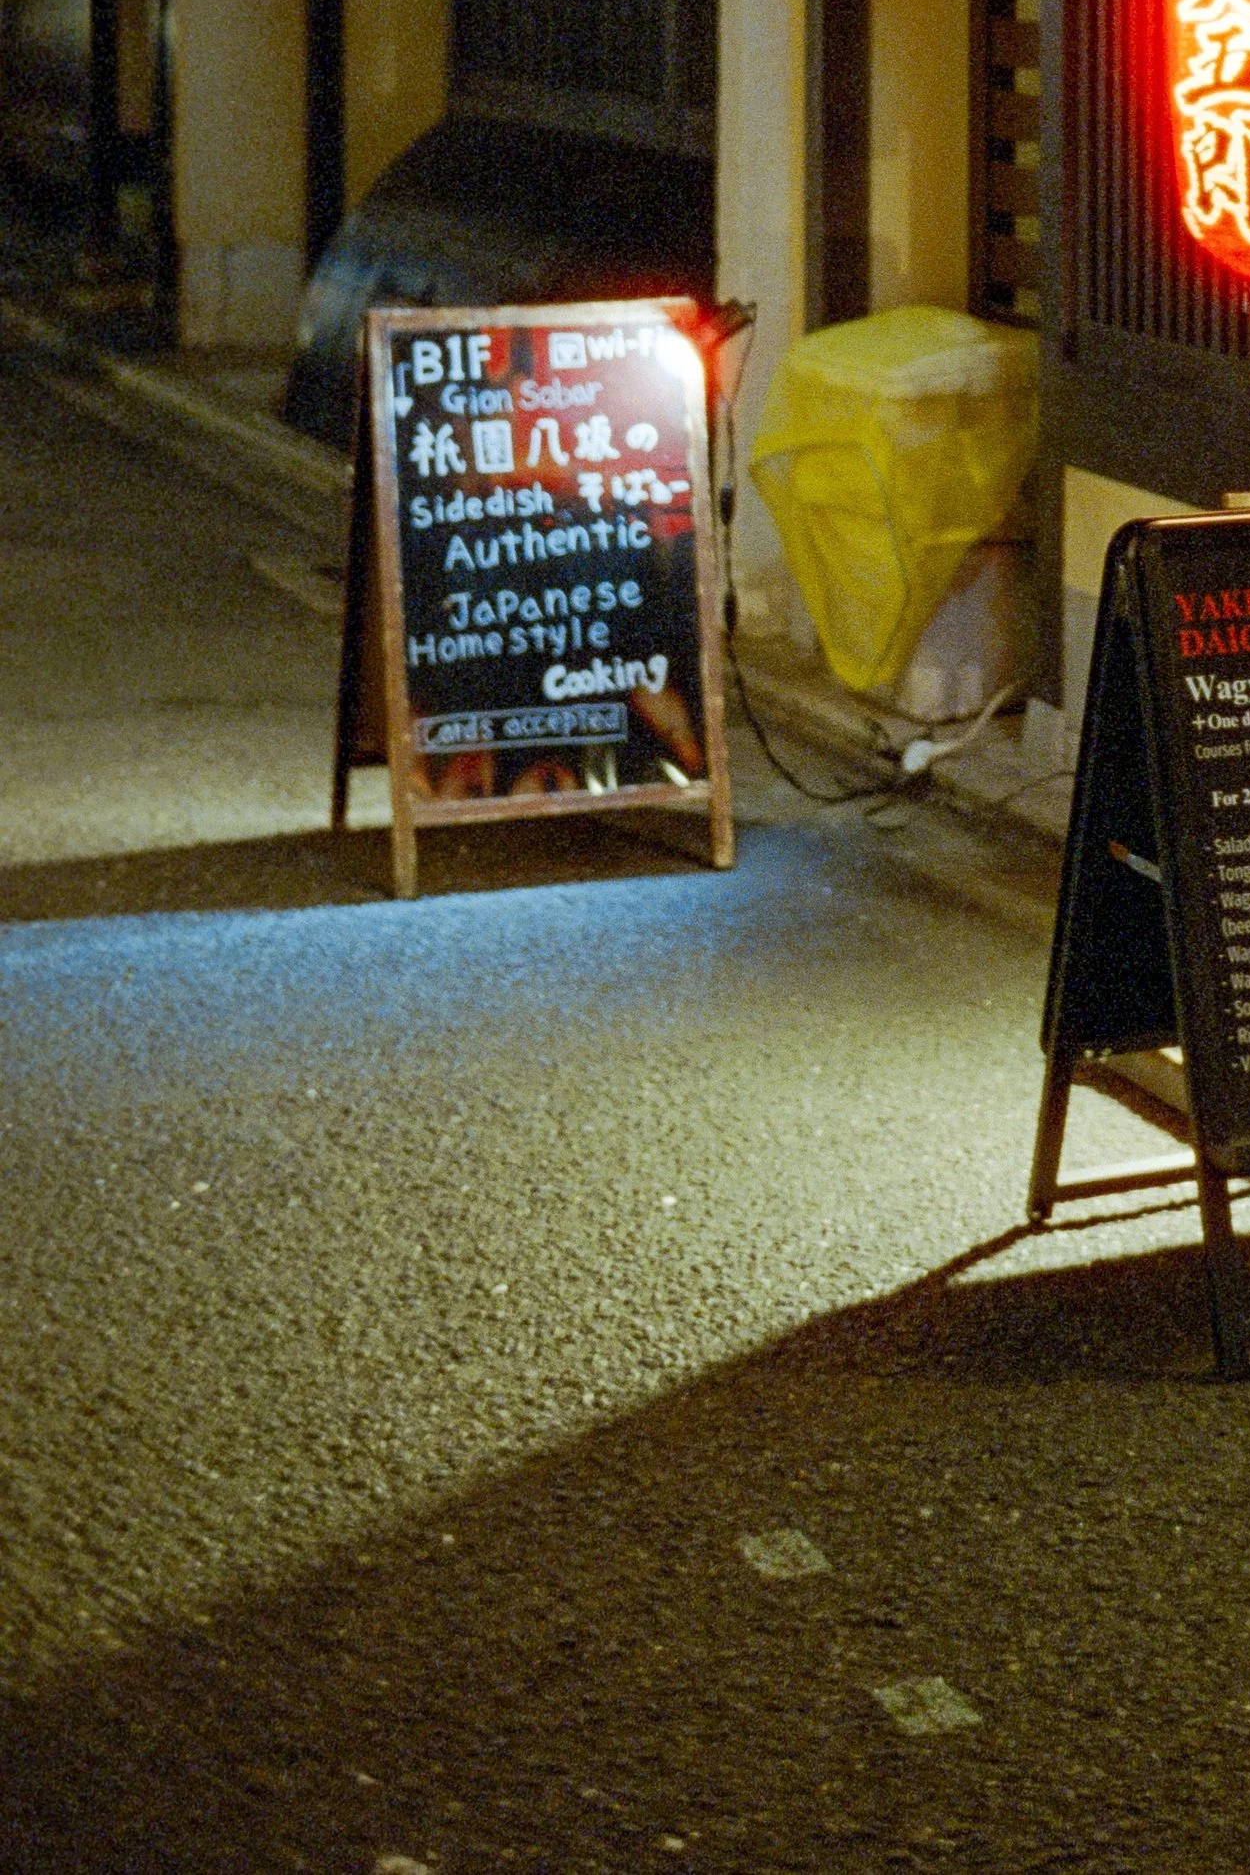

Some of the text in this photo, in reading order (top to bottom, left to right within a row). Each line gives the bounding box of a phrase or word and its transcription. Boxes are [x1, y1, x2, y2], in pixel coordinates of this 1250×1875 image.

[410, 334, 491, 385] B1F
[439, 382, 513, 416] Gion
[444, 515, 652, 572] Authentic
[542, 653, 669, 701] Cooking
[1195, 741, 1242, 759] Courses
[1211, 790, 1239, 808] For
